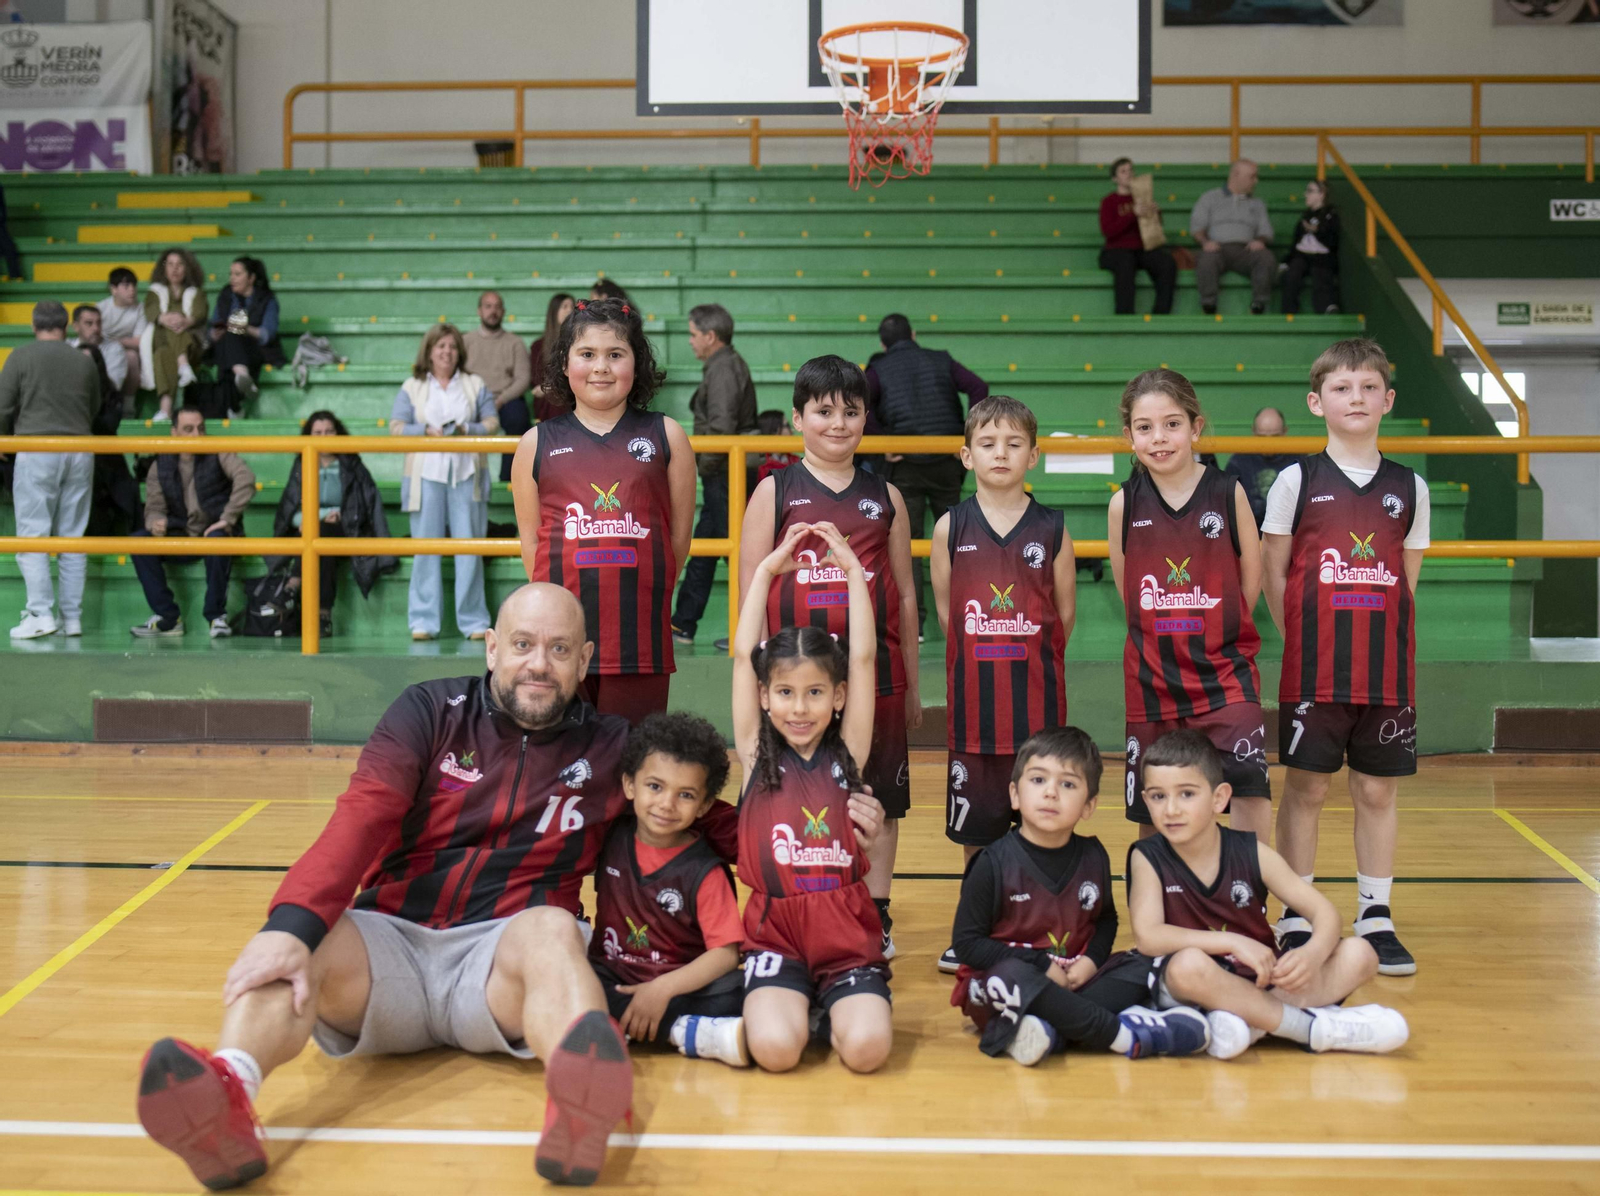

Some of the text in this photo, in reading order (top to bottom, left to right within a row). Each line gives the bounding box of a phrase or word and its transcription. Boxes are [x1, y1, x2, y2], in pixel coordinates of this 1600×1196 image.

[1553, 203, 1586, 217] WC
[578, 511, 642, 538] Gamallo
[1335, 561, 1392, 585] Gamallo
[1154, 585, 1210, 609] Gamallo
[977, 612, 1033, 635] Gamallo
[790, 839, 848, 867] Gamallo
